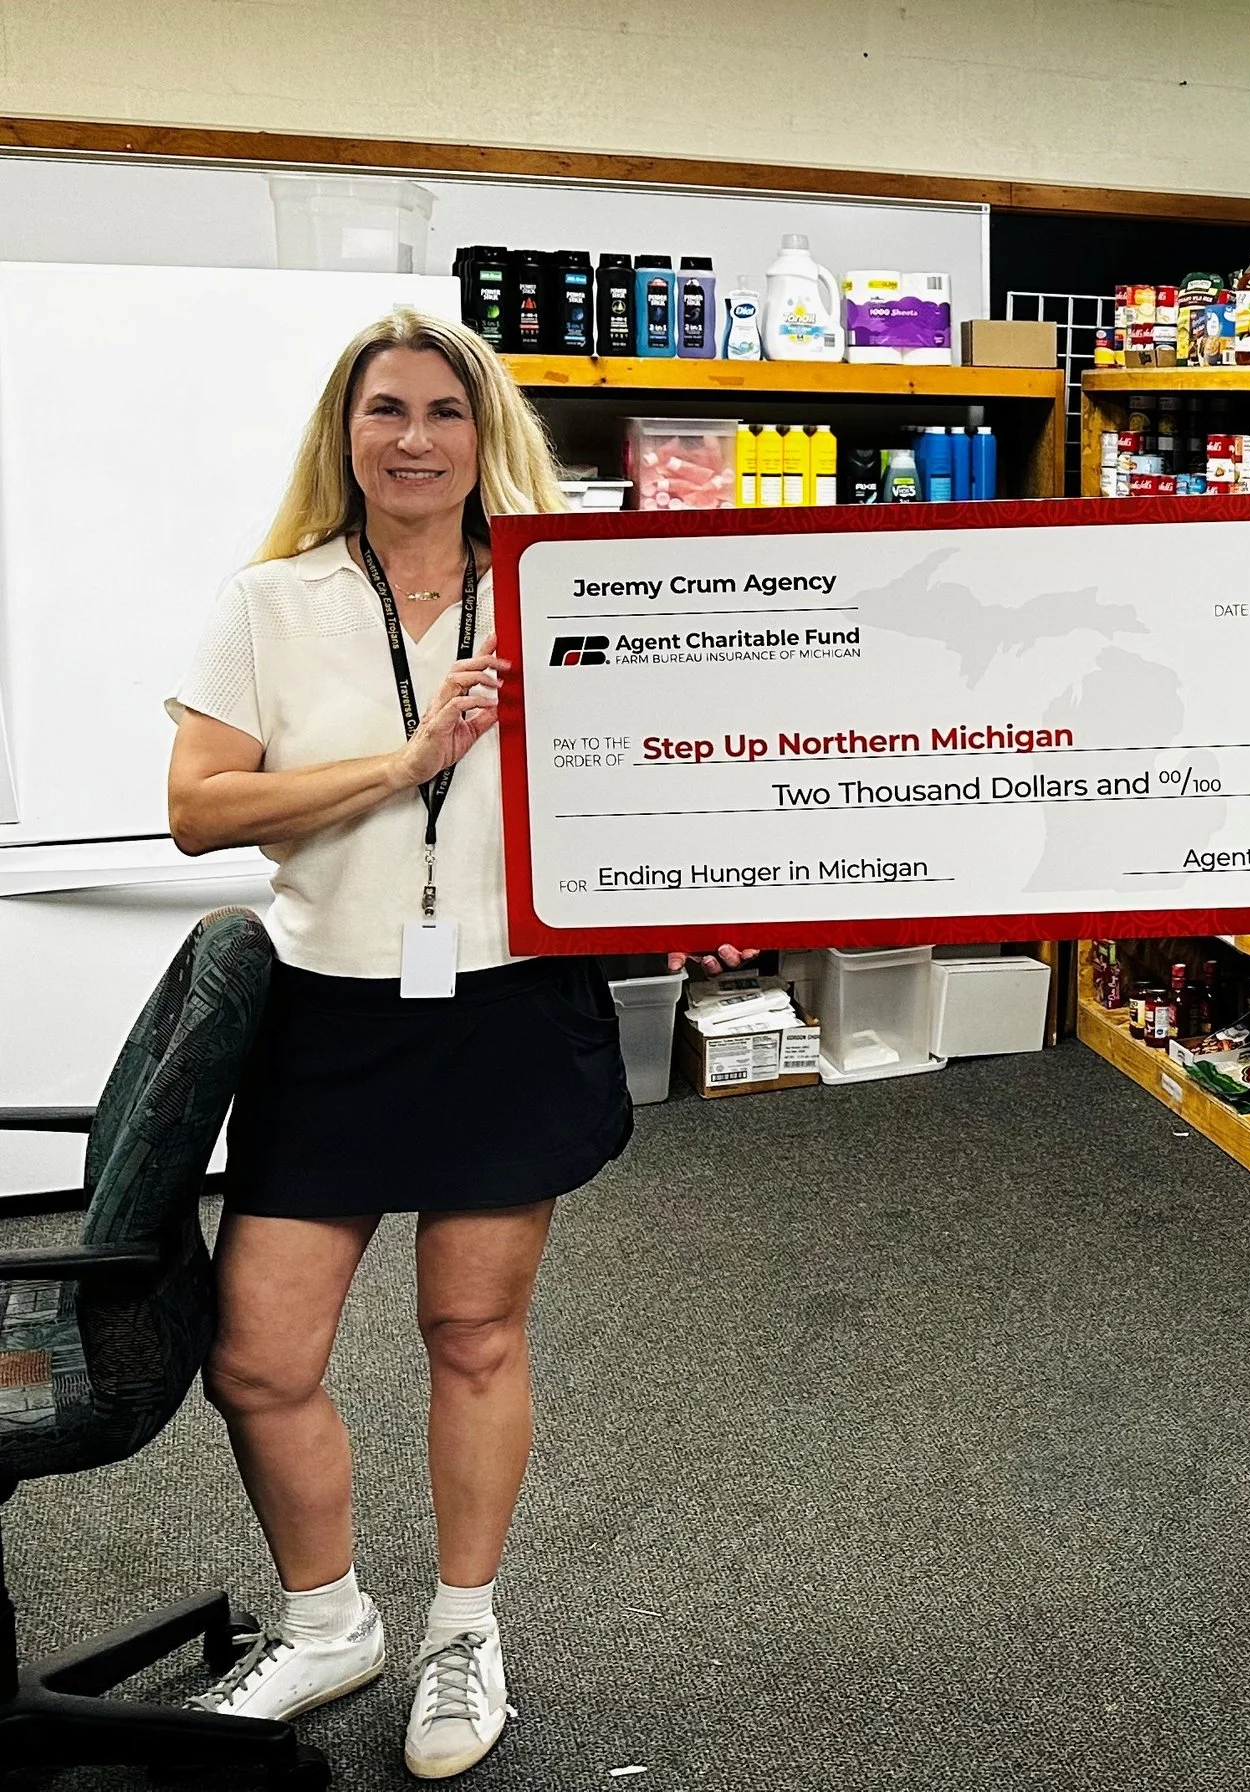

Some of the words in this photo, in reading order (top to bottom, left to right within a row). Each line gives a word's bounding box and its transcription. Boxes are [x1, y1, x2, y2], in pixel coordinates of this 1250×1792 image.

[736, 306, 755, 316] Dial
[870, 308, 890, 316] 1000
[890, 308, 918, 316] Sheets
[364, 549, 382, 584] Traverse
[375, 581, 388, 598] City
[382, 597, 393, 617] East
[388, 617, 400, 650] Trojans
[573, 578, 664, 600] Jeremy
[670, 574, 736, 596] Crum
[743, 572, 837, 595] Agency
[1214, 604, 1249, 618] DATE
[615, 632, 680, 654] Agent
[686, 628, 800, 650] Charitable
[805, 627, 860, 646] Fund
[615, 654, 650, 665] FARM
[652, 652, 702, 664] BUREAU
[706, 650, 776, 662] INSURANCE
[779, 649, 796, 660] OF
[800, 648, 861, 660] MICHIGAN
[399, 680, 412, 718] Traverse
[553, 738, 576, 751] PAY
[581, 737, 600, 750] TO
[604, 736, 630, 750] THE
[642, 736, 714, 764] Step
[724, 733, 768, 762] Up
[778, 730, 920, 756] Northern
[930, 725, 1073, 753] Michigan
[554, 754, 602, 768] ORDER
[605, 754, 625, 766] OF
[772, 783, 830, 807] Two
[838, 776, 980, 803] Thousand
[992, 773, 1088, 800] Dollars
[1097, 770, 1150, 796] and
[559, 880, 588, 892] FOR
[599, 866, 682, 889] Ending
[690, 863, 781, 887] Hunger
[789, 862, 810, 880] in
[819, 858, 928, 882] Michigan
